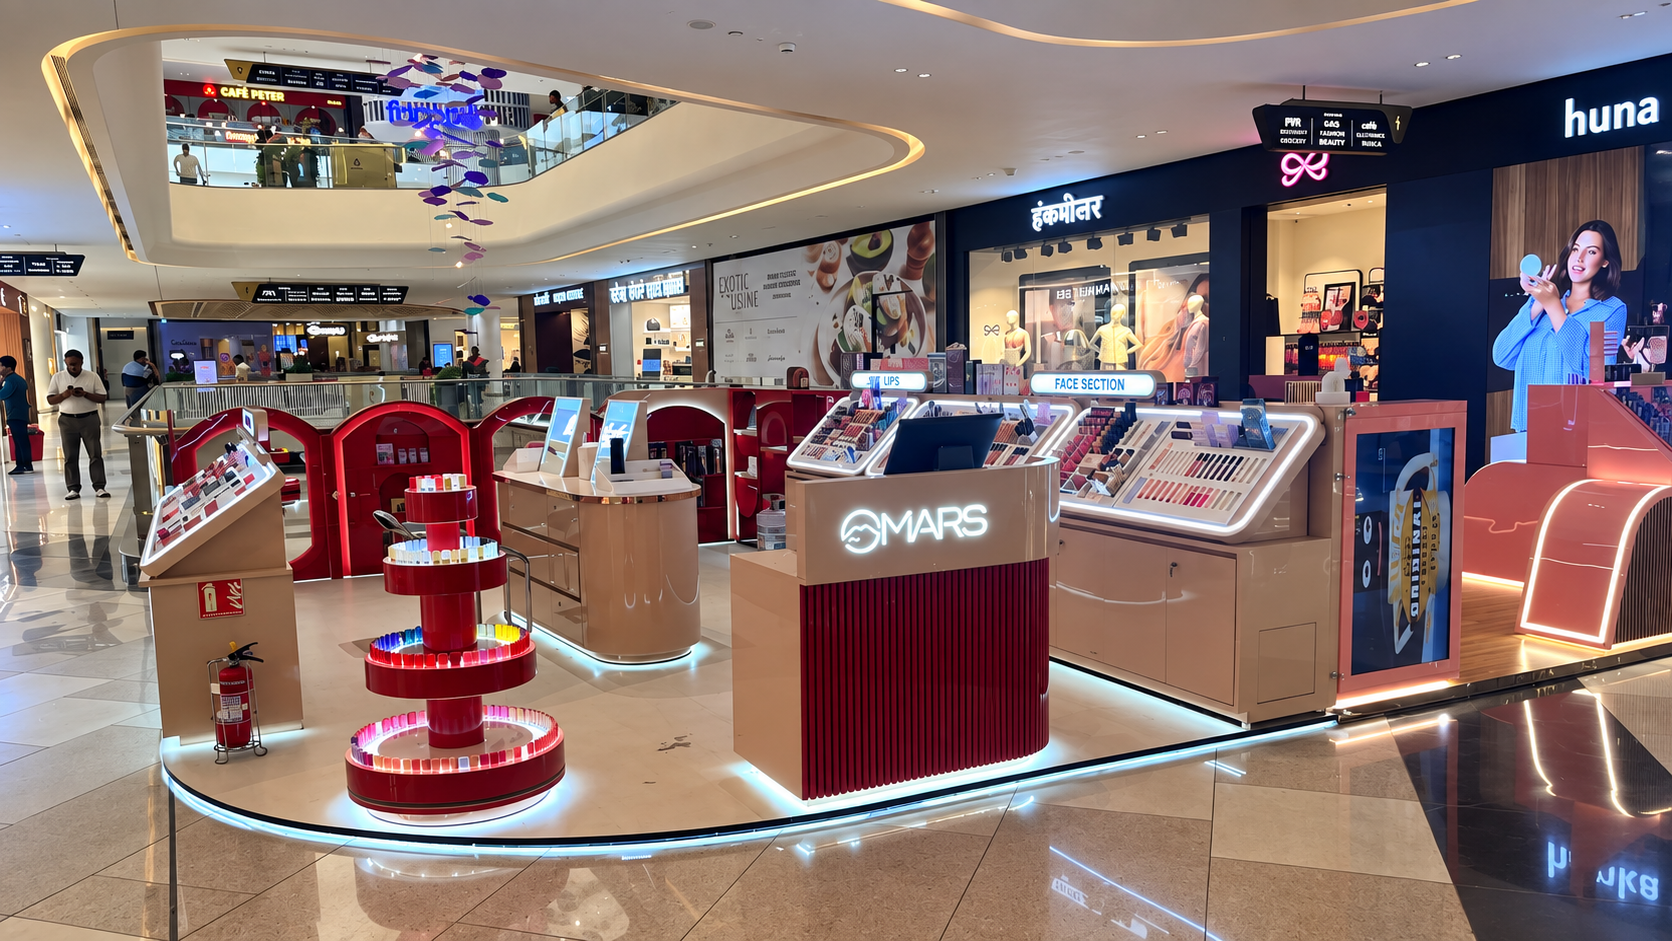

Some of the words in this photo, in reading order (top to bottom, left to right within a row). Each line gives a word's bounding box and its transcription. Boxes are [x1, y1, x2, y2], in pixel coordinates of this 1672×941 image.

[251, 88, 285, 102] PETER
[1564, 96, 1660, 138] huna
[1318, 138, 1346, 147] BEAUTY
[719, 272, 749, 294] EXOTIC
[721, 290, 759, 310] USINE
[883, 375, 901, 387] LIPS
[1054, 377, 1079, 390] FACE
[1081, 377, 1125, 391] SECTION
